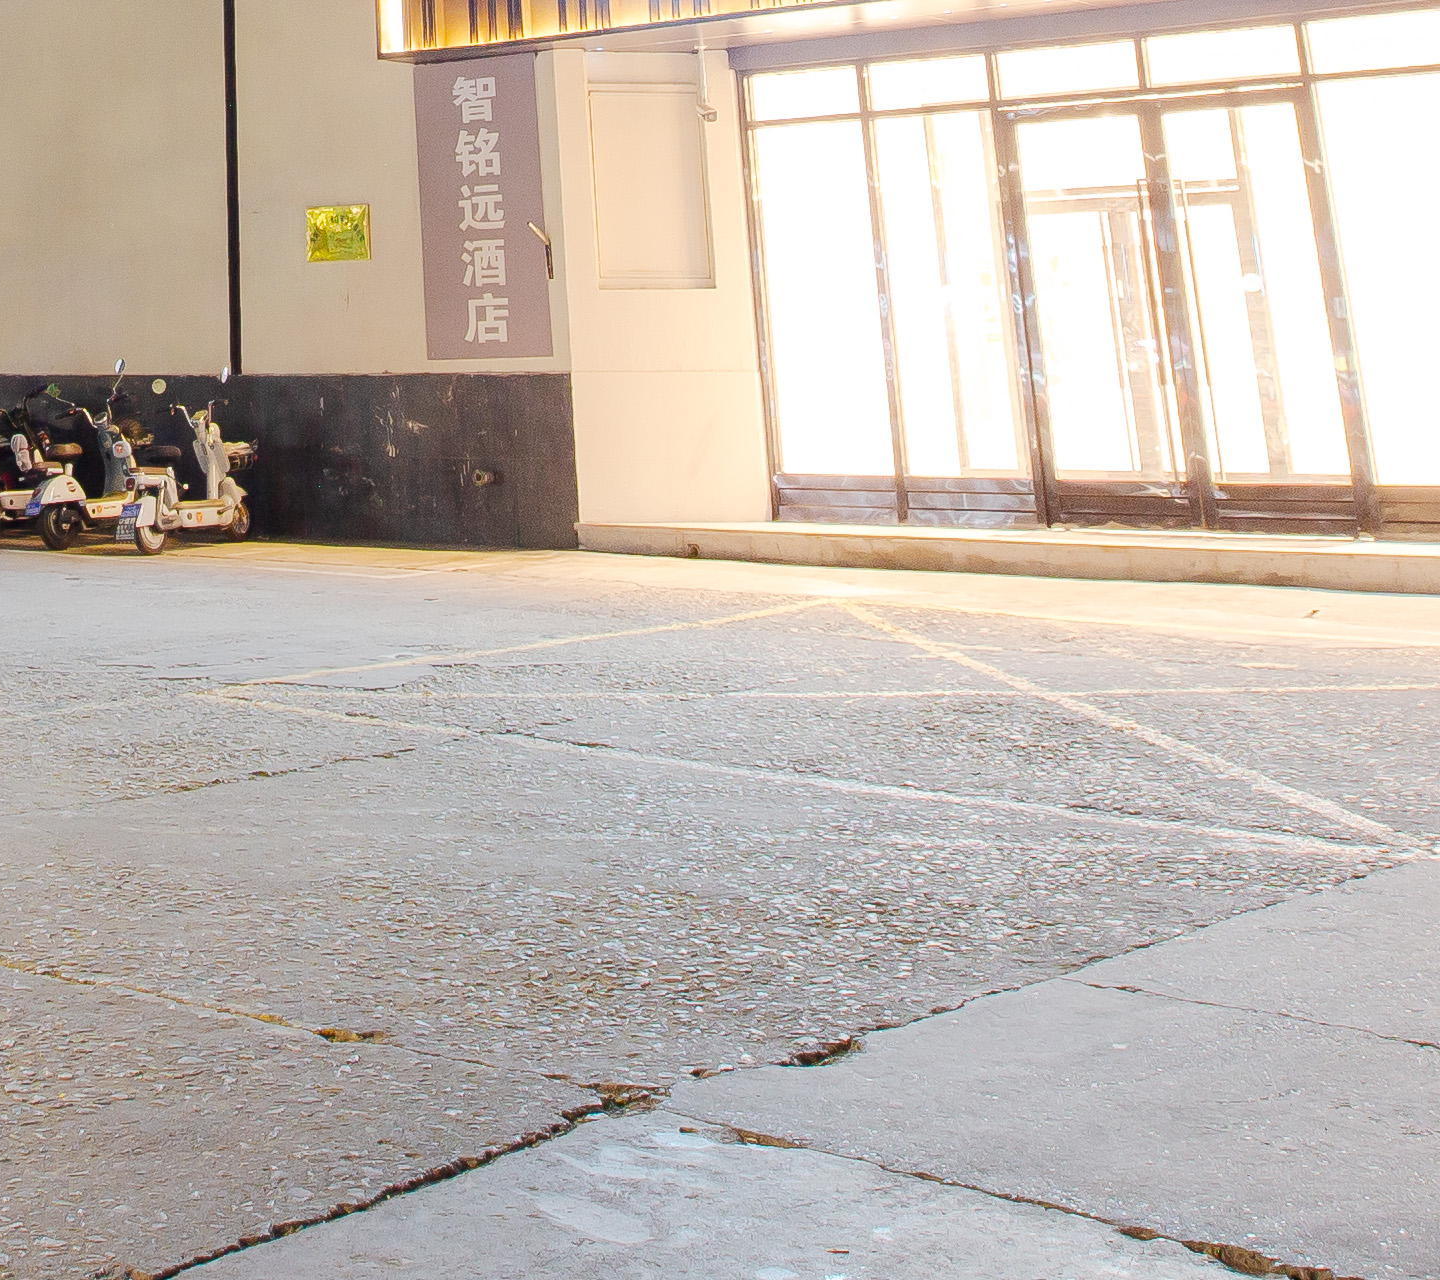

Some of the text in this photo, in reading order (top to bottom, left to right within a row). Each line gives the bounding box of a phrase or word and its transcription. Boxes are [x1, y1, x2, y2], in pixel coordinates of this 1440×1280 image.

[452, 75, 509, 345] 智铭远酒店
